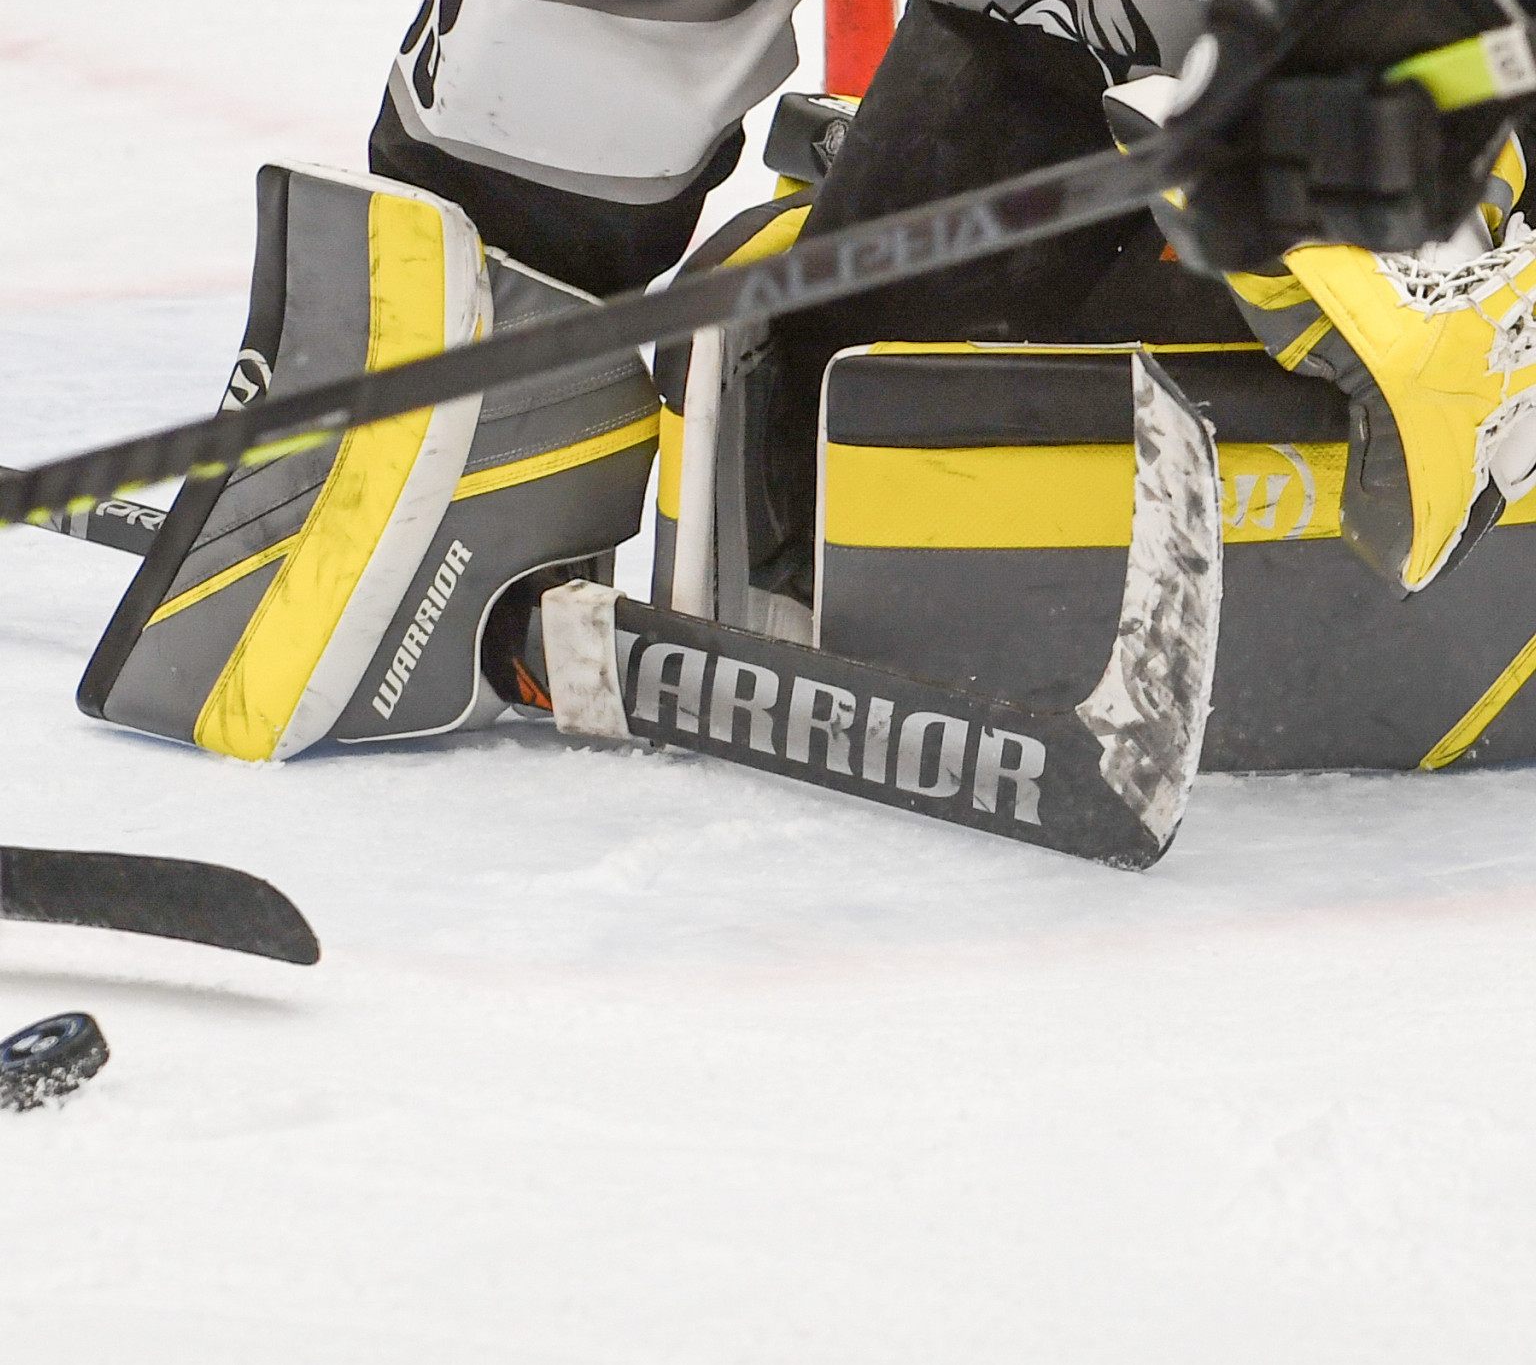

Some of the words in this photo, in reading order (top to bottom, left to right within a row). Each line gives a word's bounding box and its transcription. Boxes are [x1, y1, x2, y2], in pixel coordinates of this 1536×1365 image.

[735, 200, 1005, 325] ALPHA
[372, 539, 473, 720] WARRIOR
[617, 630, 1046, 825] ARRIOR
